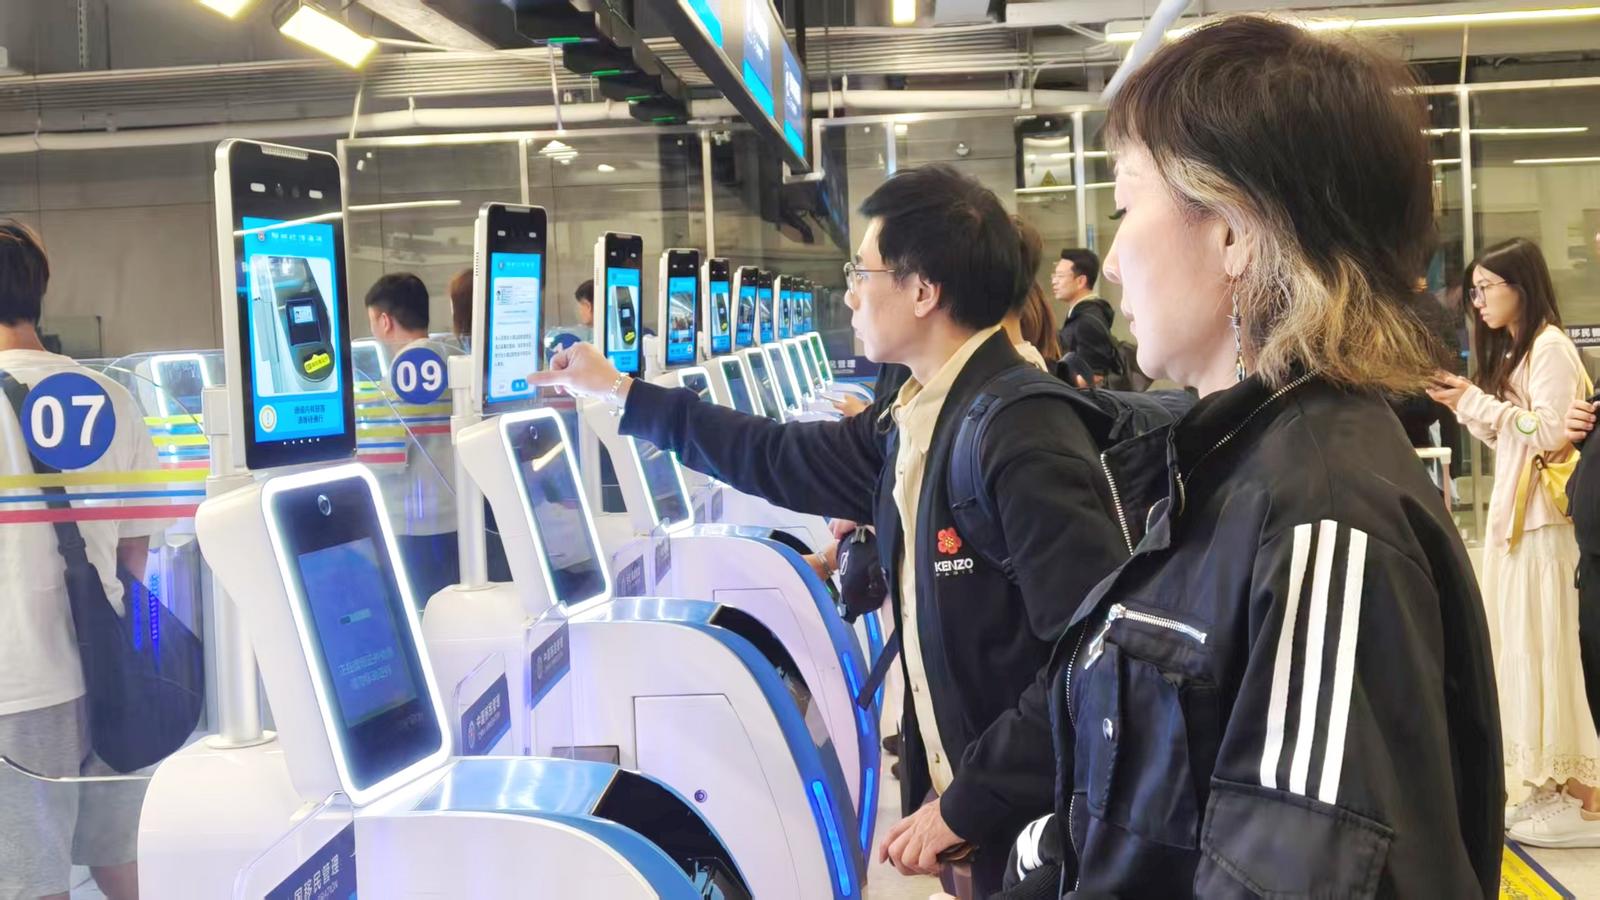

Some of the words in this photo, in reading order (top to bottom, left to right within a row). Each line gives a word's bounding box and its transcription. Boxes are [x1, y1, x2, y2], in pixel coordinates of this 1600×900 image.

[396, 360, 441, 392] 09
[31, 395, 105, 448] 07
[934, 558, 974, 573] KENZO
